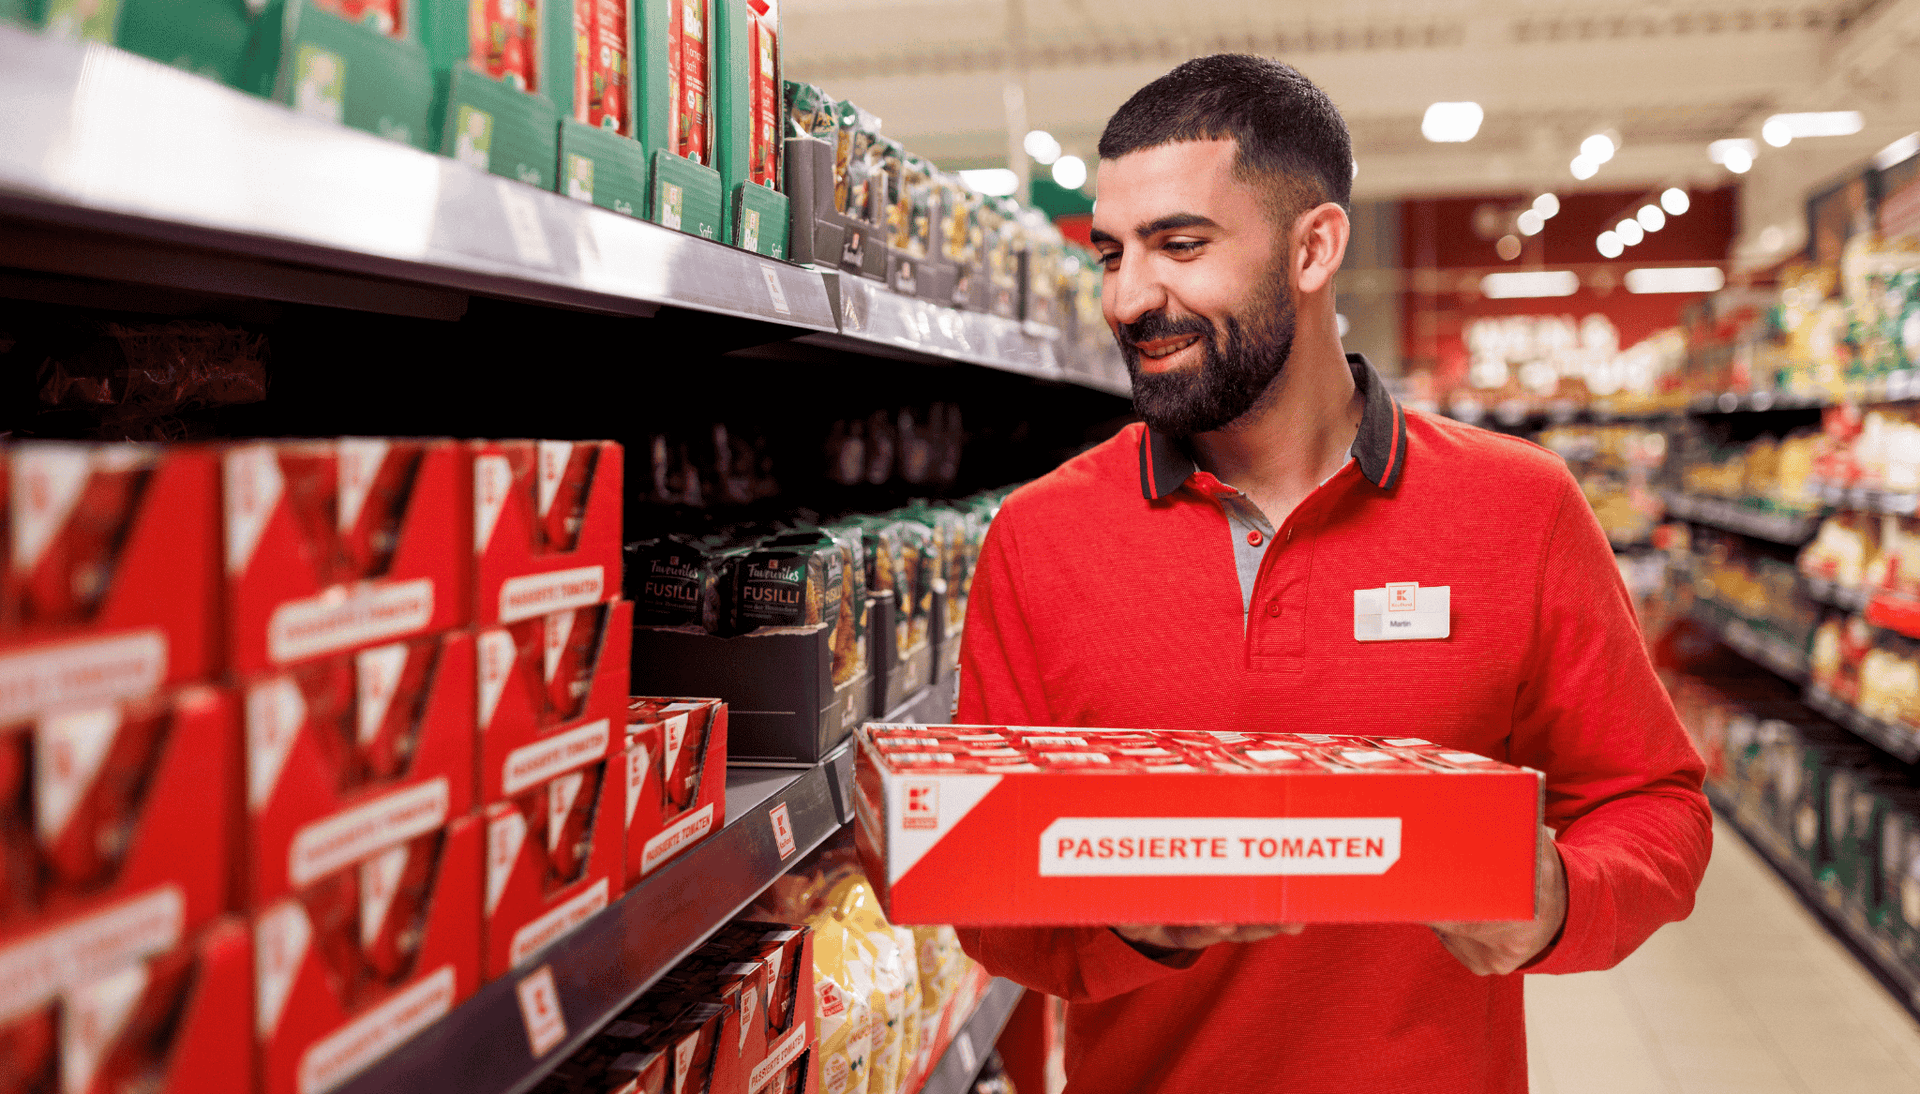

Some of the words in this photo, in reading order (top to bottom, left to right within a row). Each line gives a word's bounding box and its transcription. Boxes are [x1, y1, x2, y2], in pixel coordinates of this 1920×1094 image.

[645, 581, 699, 601] FUSILLI
[743, 586, 800, 604] FUSILLI
[682, 813, 712, 838] TOMATEN
[1057, 836, 1228, 859] PASSIERTE
[1239, 837, 1386, 858] TOMATEN
[751, 1054, 780, 1088] PASSIERTE
[781, 1031, 804, 1061] TOMATEN
